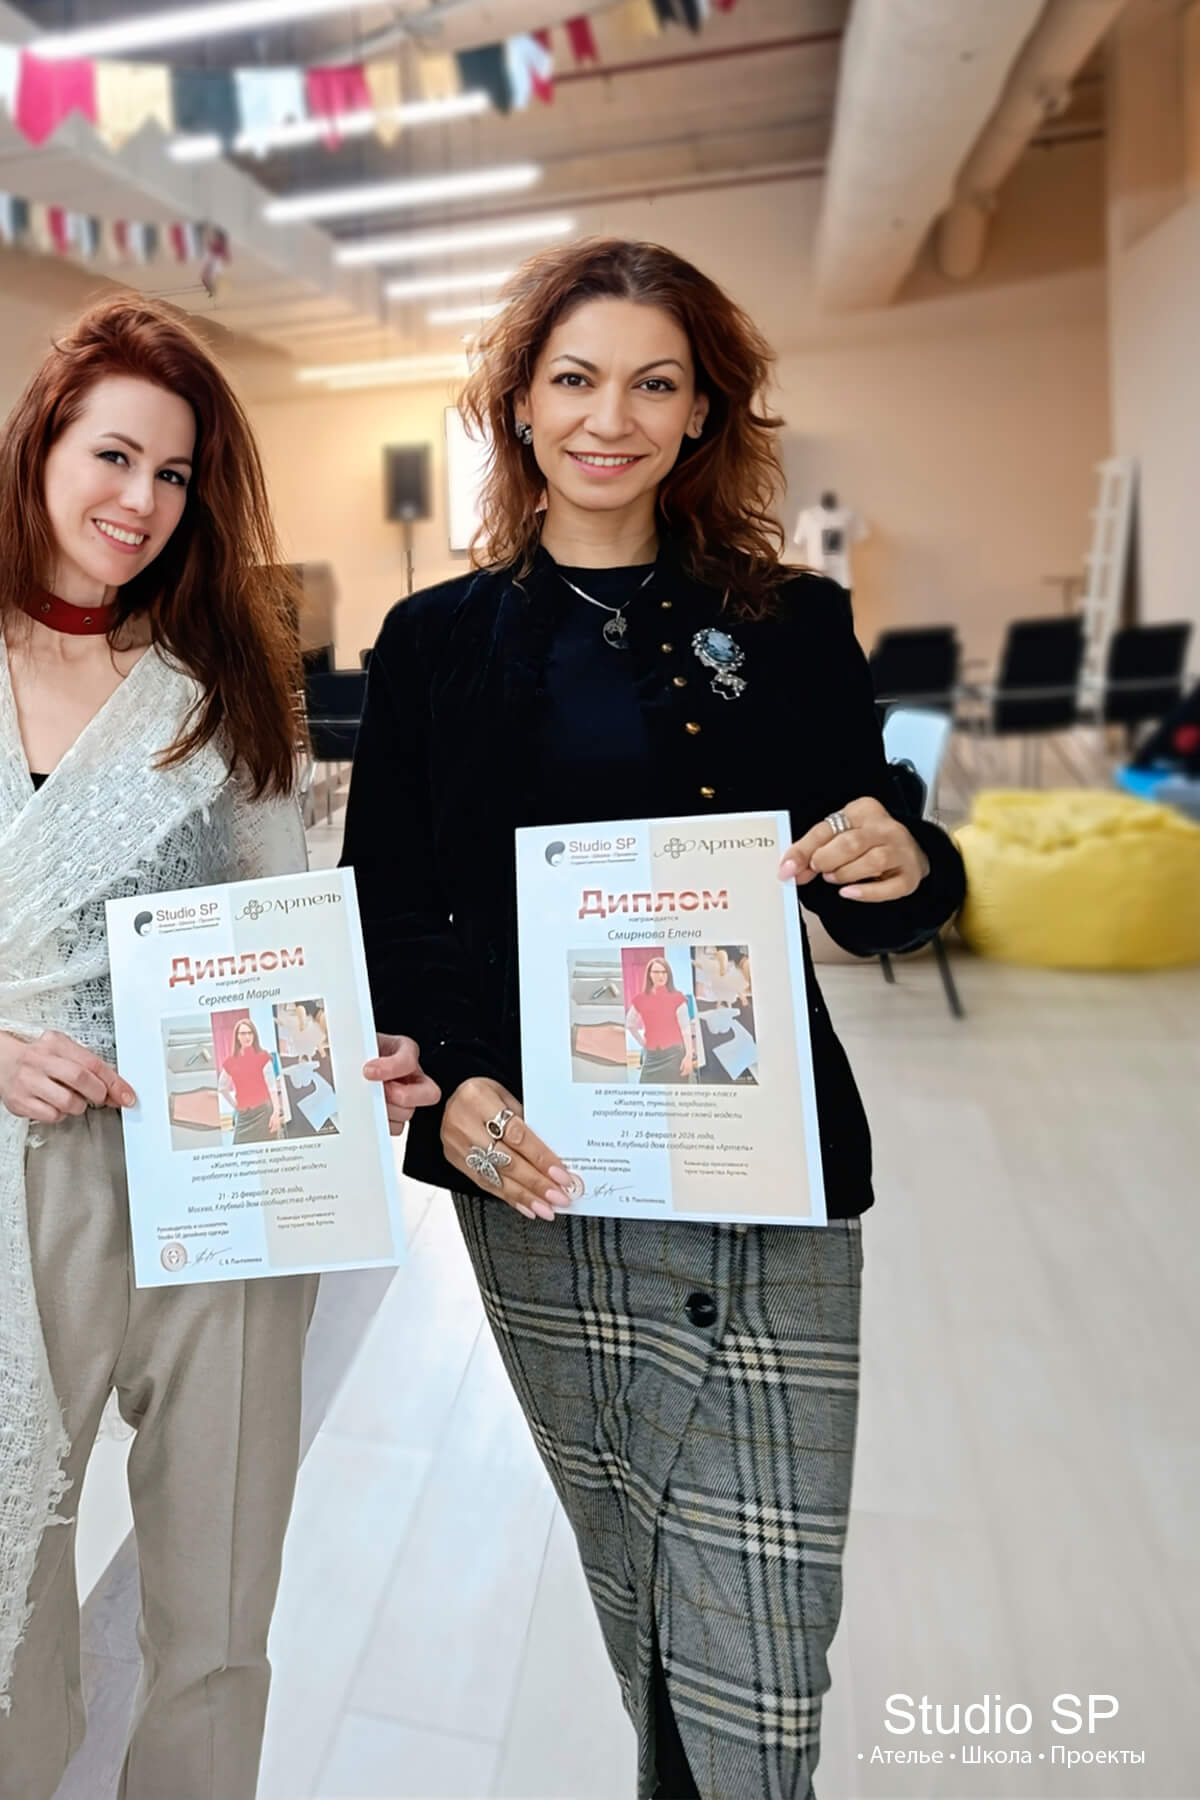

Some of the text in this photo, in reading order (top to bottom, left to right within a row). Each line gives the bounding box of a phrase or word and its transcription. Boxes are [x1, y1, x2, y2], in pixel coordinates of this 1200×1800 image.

[569, 837, 636, 853] Studio SP
[697, 836, 775, 855] Артель
[156, 902, 218, 922] Studio SP
[272, 892, 342, 914] Артель
[578, 889, 729, 920] Диплом
[607, 927, 702, 941] Смирнова Елена
[169, 947, 305, 988] Диплом
[198, 987, 281, 1007] Сергеева Мария
